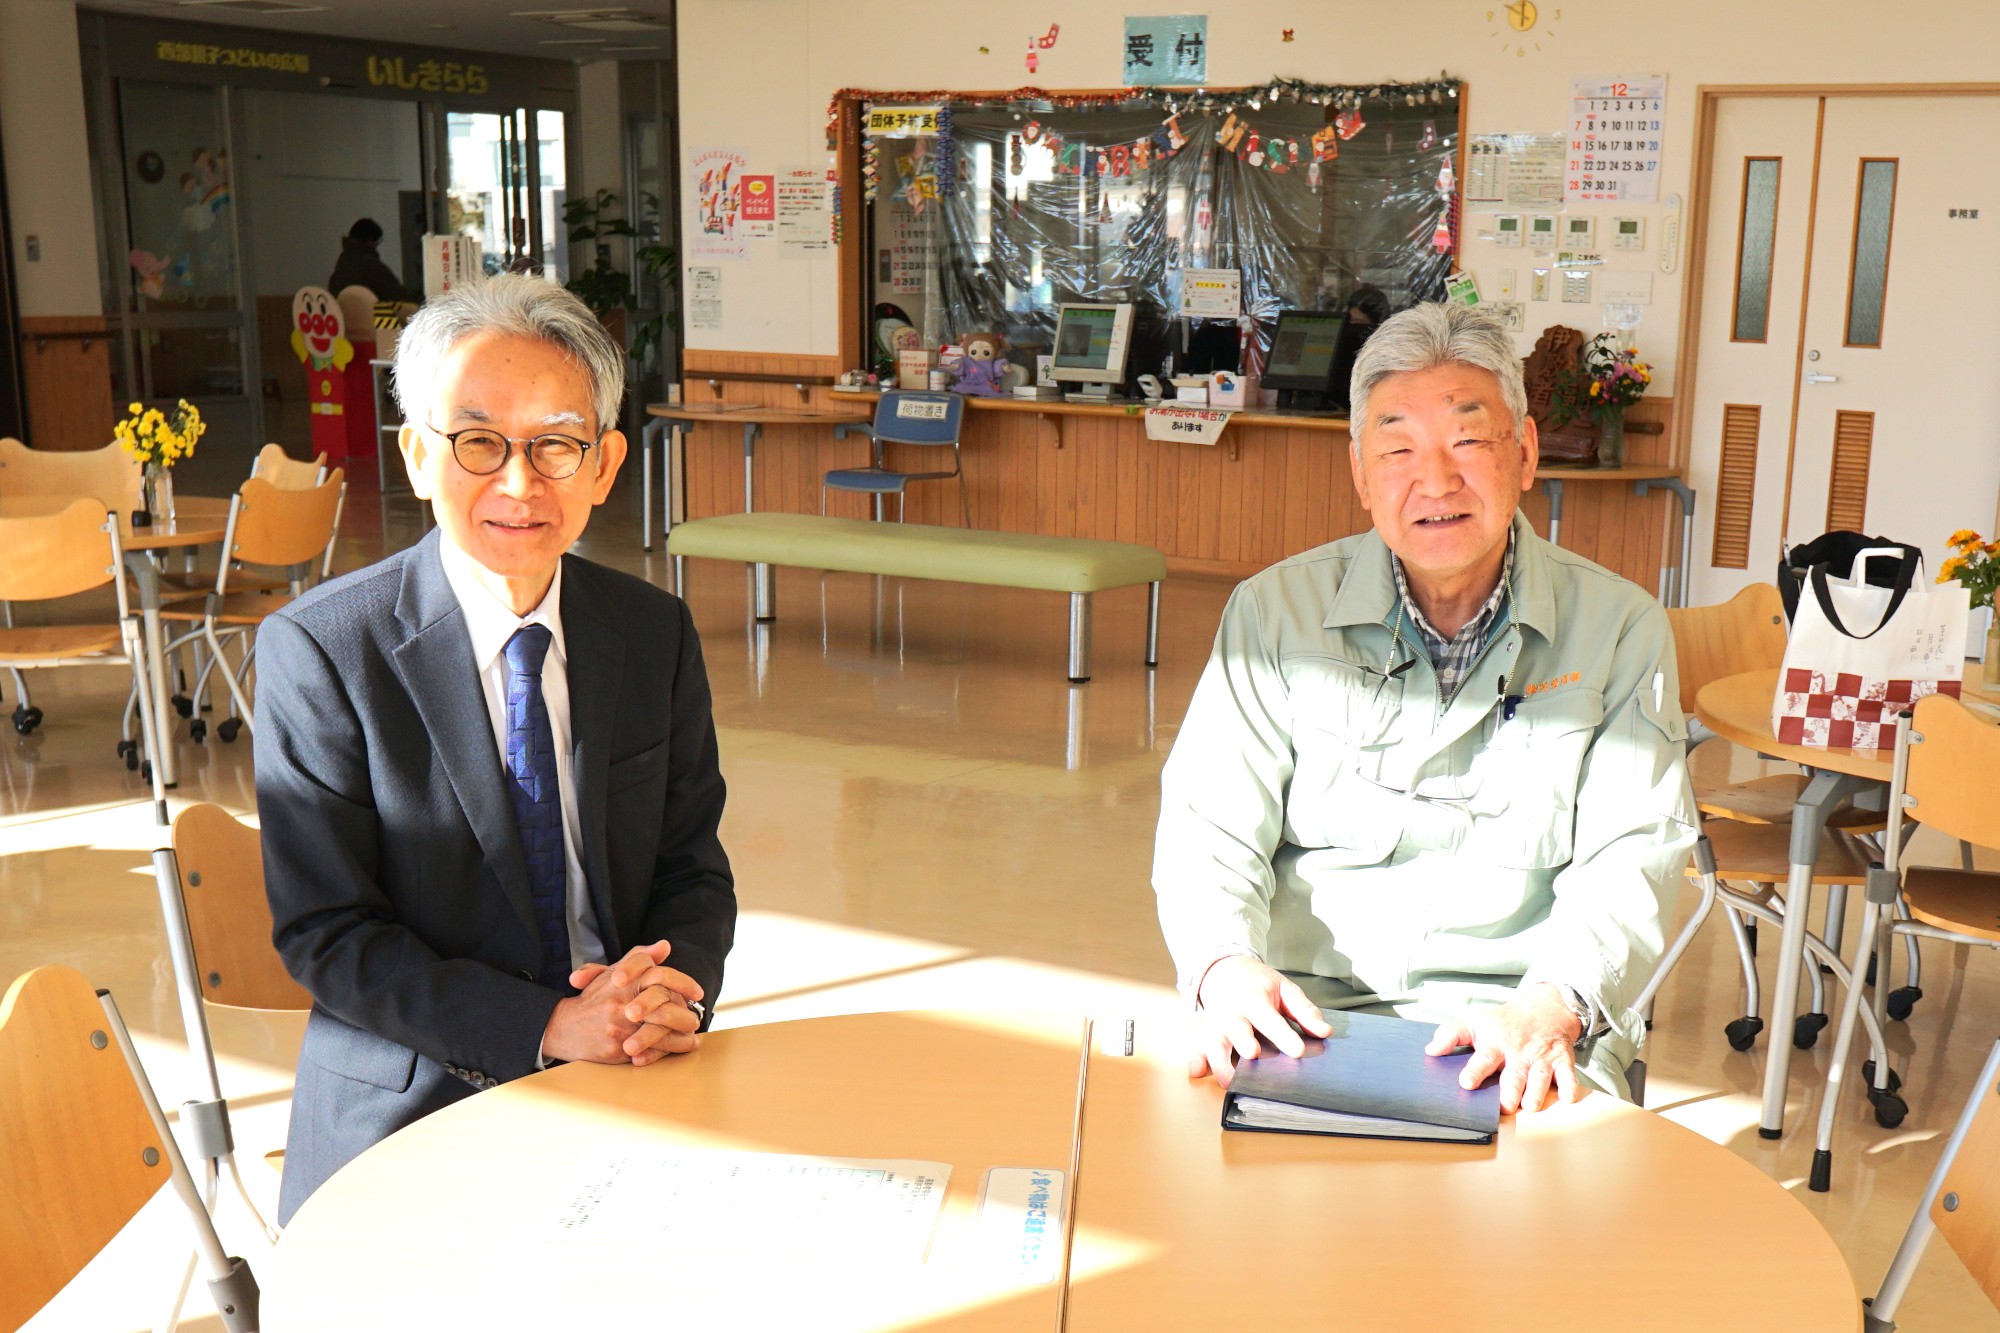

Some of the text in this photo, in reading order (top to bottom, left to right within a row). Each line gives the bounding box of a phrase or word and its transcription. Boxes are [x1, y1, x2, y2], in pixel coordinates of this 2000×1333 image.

[1554, 9, 1561, 20] 3
[1127, 33, 1203, 67] 受付
[367, 55, 489, 95] いしきらら
[1610, 83, 1628, 96] 12
[1575, 121, 1659, 131] 7 8 9 10 11 12 13
[1572, 141, 1658, 151] 14 15 16 17 18 19 20
[1571, 161, 1656, 171] 21 22 23 24 25 26 27
[1569, 180, 1617, 190] 28 29 30 31
[902, 403, 943, 417] 荷物置き
[1172, 421, 1203, 432] あります
